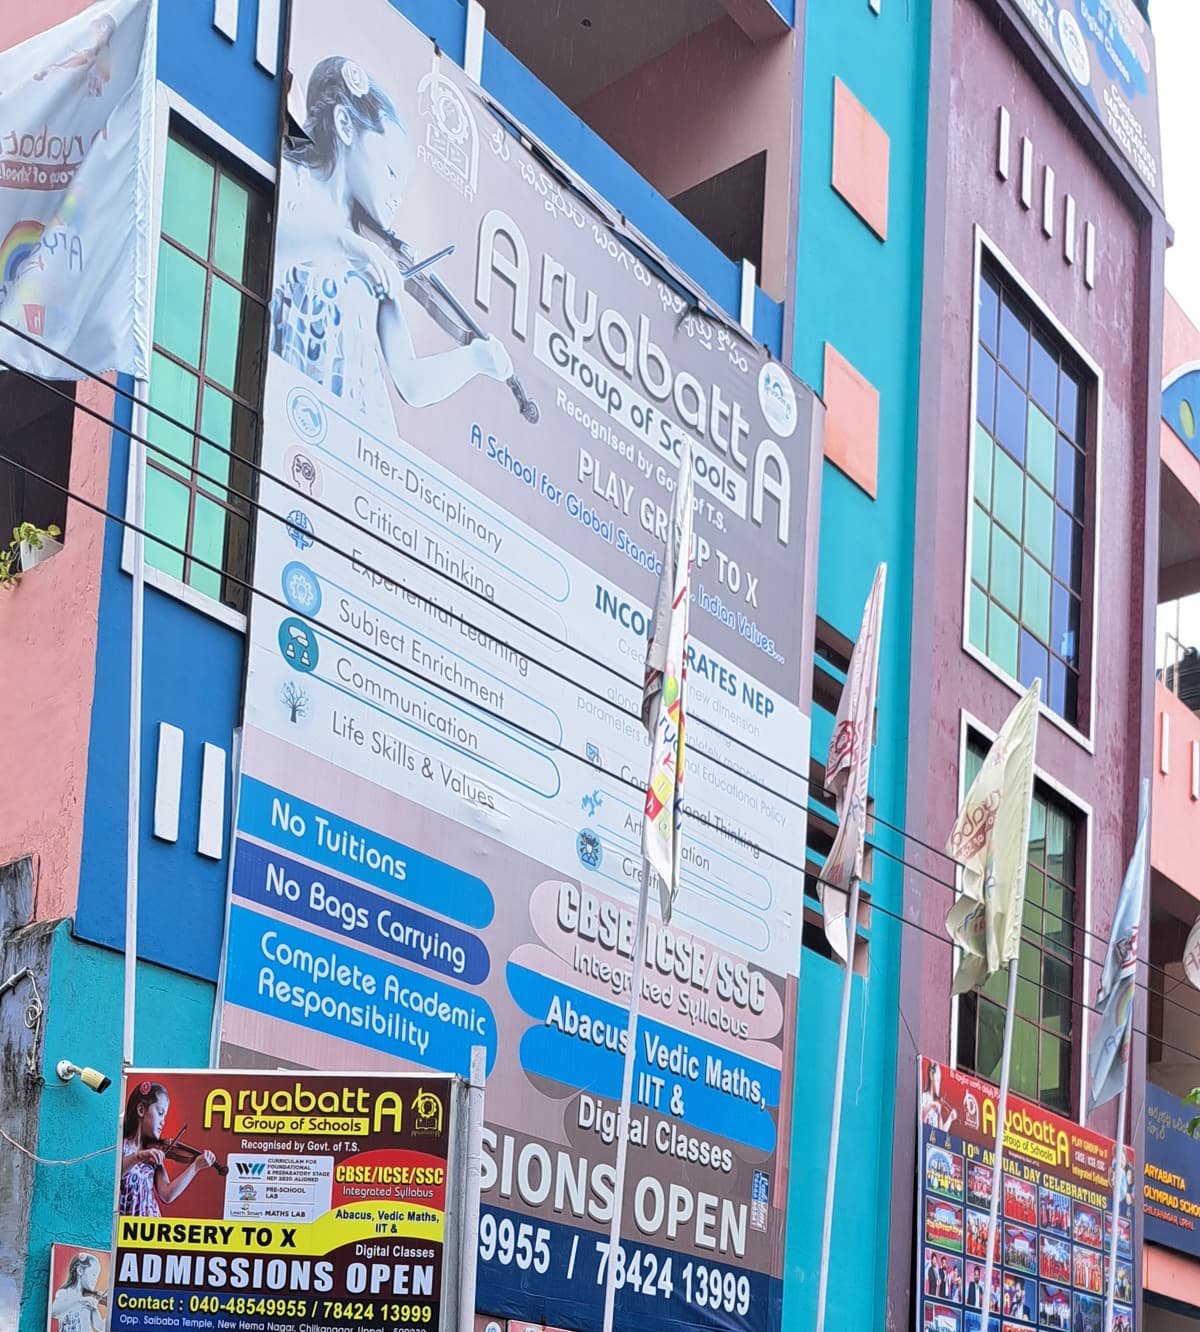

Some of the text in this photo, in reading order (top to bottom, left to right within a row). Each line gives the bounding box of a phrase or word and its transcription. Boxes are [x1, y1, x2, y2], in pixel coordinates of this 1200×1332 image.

[475, 209, 792, 546] AryabattA
[549, 330, 736, 502] Group of Scools
[557, 387, 727, 533] Recognised by T.S.
[357, 437, 502, 554] Inter-Disciplinary
[354, 495, 496, 601] Critical Thinking
[470, 424, 482, 448] A
[488, 436, 538, 488] School
[541, 475, 563, 500] for
[566, 493, 613, 543] Global
[699, 585, 736, 629] Indian
[577, 448, 635, 516] PLAY
[716, 550, 741, 596] TO
[745, 571, 761, 610] X
[351, 548, 529, 677] Experiential Learning
[338, 599, 505, 710] Subject Enrichment
[336, 657, 478, 750] Communication
[711, 698, 760, 737] dimension
[742, 681, 775, 720] NEP
[332, 710, 496, 811] Life Skills & Values
[576, 695, 641, 743] parameters
[702, 766, 758, 811] Educational
[760, 798, 788, 828] Policy
[271, 797, 408, 881] No Tuitions
[714, 814, 761, 860] Thinking
[265, 863, 466, 974] No Bags Carrying
[261, 930, 487, 1036] Complete Academic
[257, 967, 430, 1056] Responsibility
[678, 991, 749, 1039] Syllabus
[637, 1072, 685, 1116] IIT &
[642, 1031, 767, 1111] Vedic Maths,
[203, 1082, 403, 1134] AryabattA
[242, 1117, 361, 1134] Group of Schools
[241, 1140, 360, 1153] Recognised by Govt. of T.S.
[655, 1120, 733, 1173] Classes
[1030, 1141, 1054, 1161] Schools
[336, 1165, 445, 1186] CBSE/ICSE/SSC
[343, 1186, 434, 1199] Integrated Syllabus
[1023, 1165, 1041, 1185] DAY
[1043, 1174, 1107, 1209] CELEBRATIONS
[1143, 1185, 1179, 1210] OLYMPIAD
[1144, 1163, 1186, 1190] ARYABATTA
[122, 1221, 297, 1248] NURSERY TO X
[335, 1209, 440, 1224] Abacus, Vedic Maths,
[375, 1223, 398, 1233] IIT &
[633, 1175, 748, 1259] OPEN
[118, 1252, 434, 1297] ADMISSIONS OPEN
[355, 1244, 436, 1259] Digital Classes
[567, 1234, 579, 1280] /
[682, 1261, 751, 1317] 13999
[117, 1292, 432, 1323] Contact : 040-48549955 / 78424 13999
[120, 1314, 141, 1326] Opp.
[143, 1315, 180, 1327] Saibaba
[182, 1317, 214, 1329] Temple,
[217, 1320, 236, 1329] New
